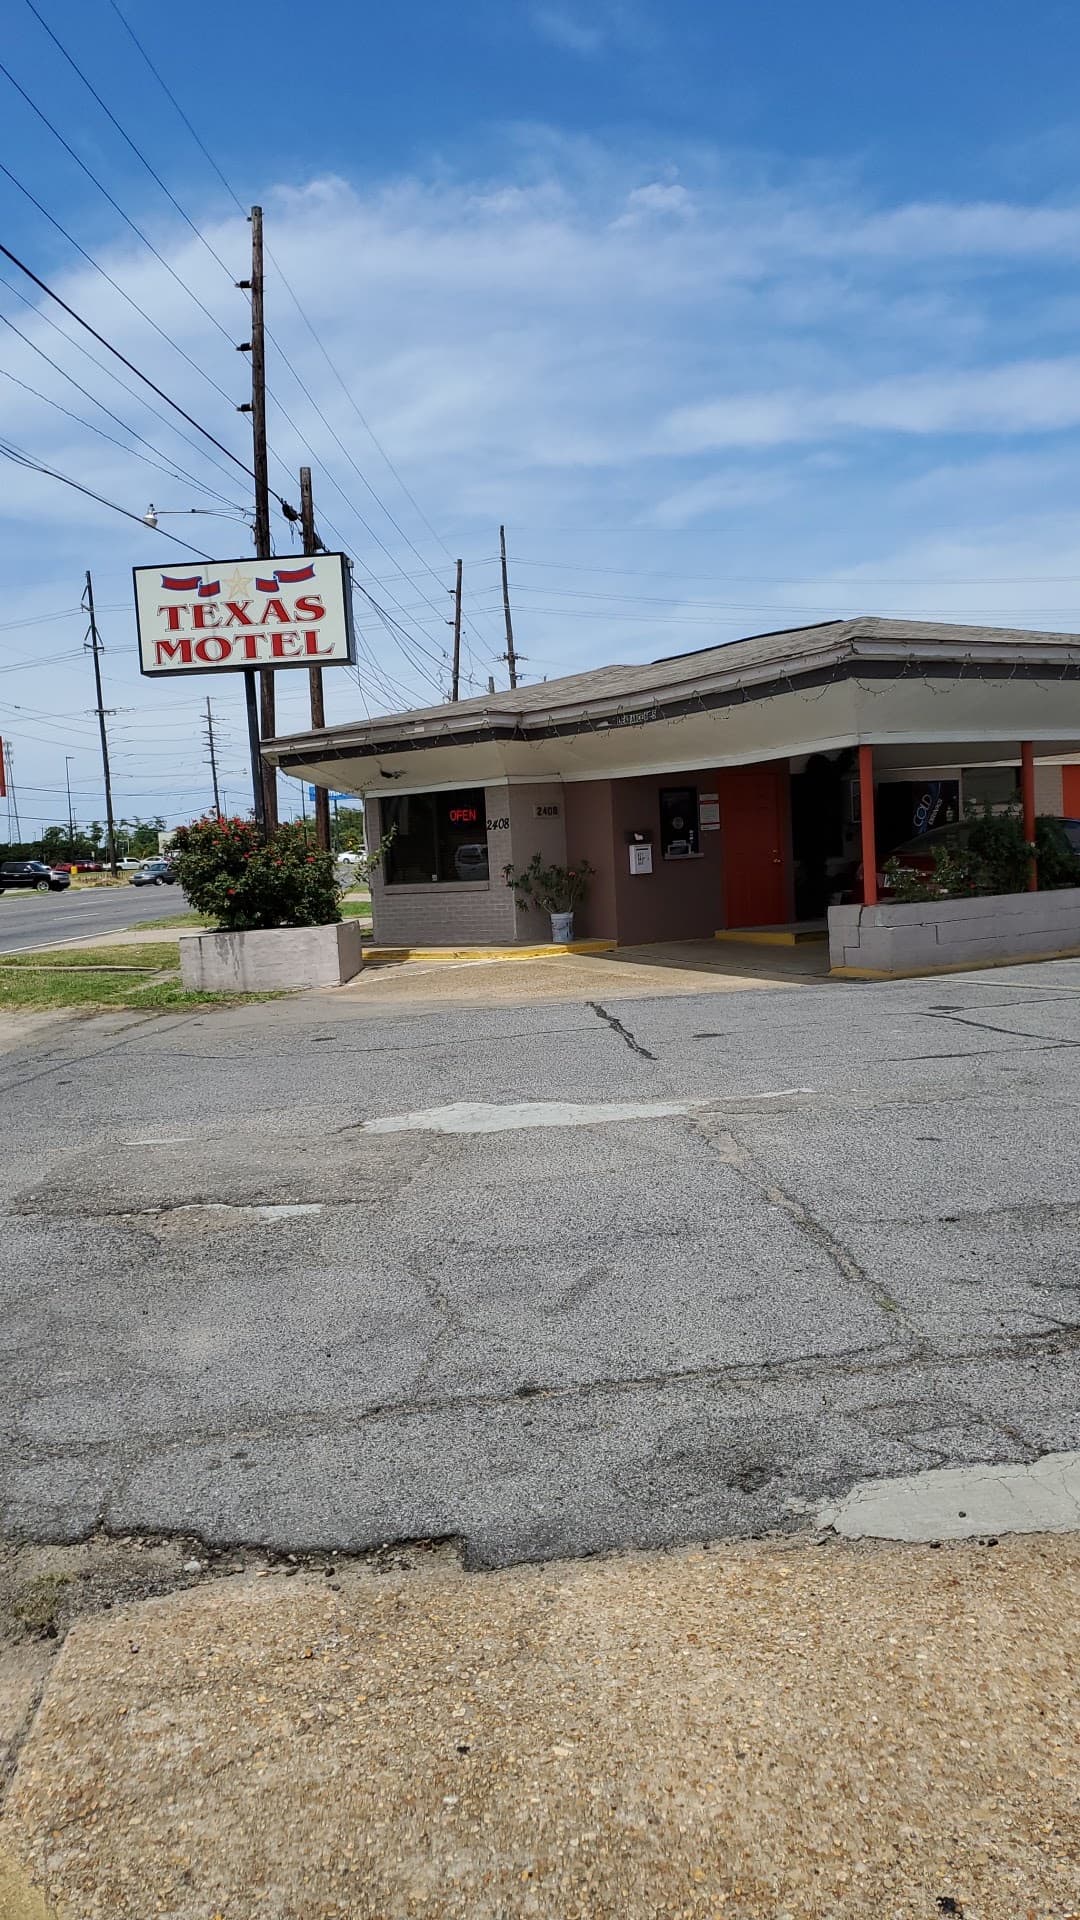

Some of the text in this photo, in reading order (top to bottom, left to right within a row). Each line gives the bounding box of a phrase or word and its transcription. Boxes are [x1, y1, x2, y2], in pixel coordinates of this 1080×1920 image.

[157, 594, 327, 632] TEXAS
[152, 629, 335, 667] MOTEL
[449, 808, 477, 822] OPEN
[536, 806, 559, 817] 2408
[913, 794, 932, 827] COLD
[486, 818, 510, 831] 2408
